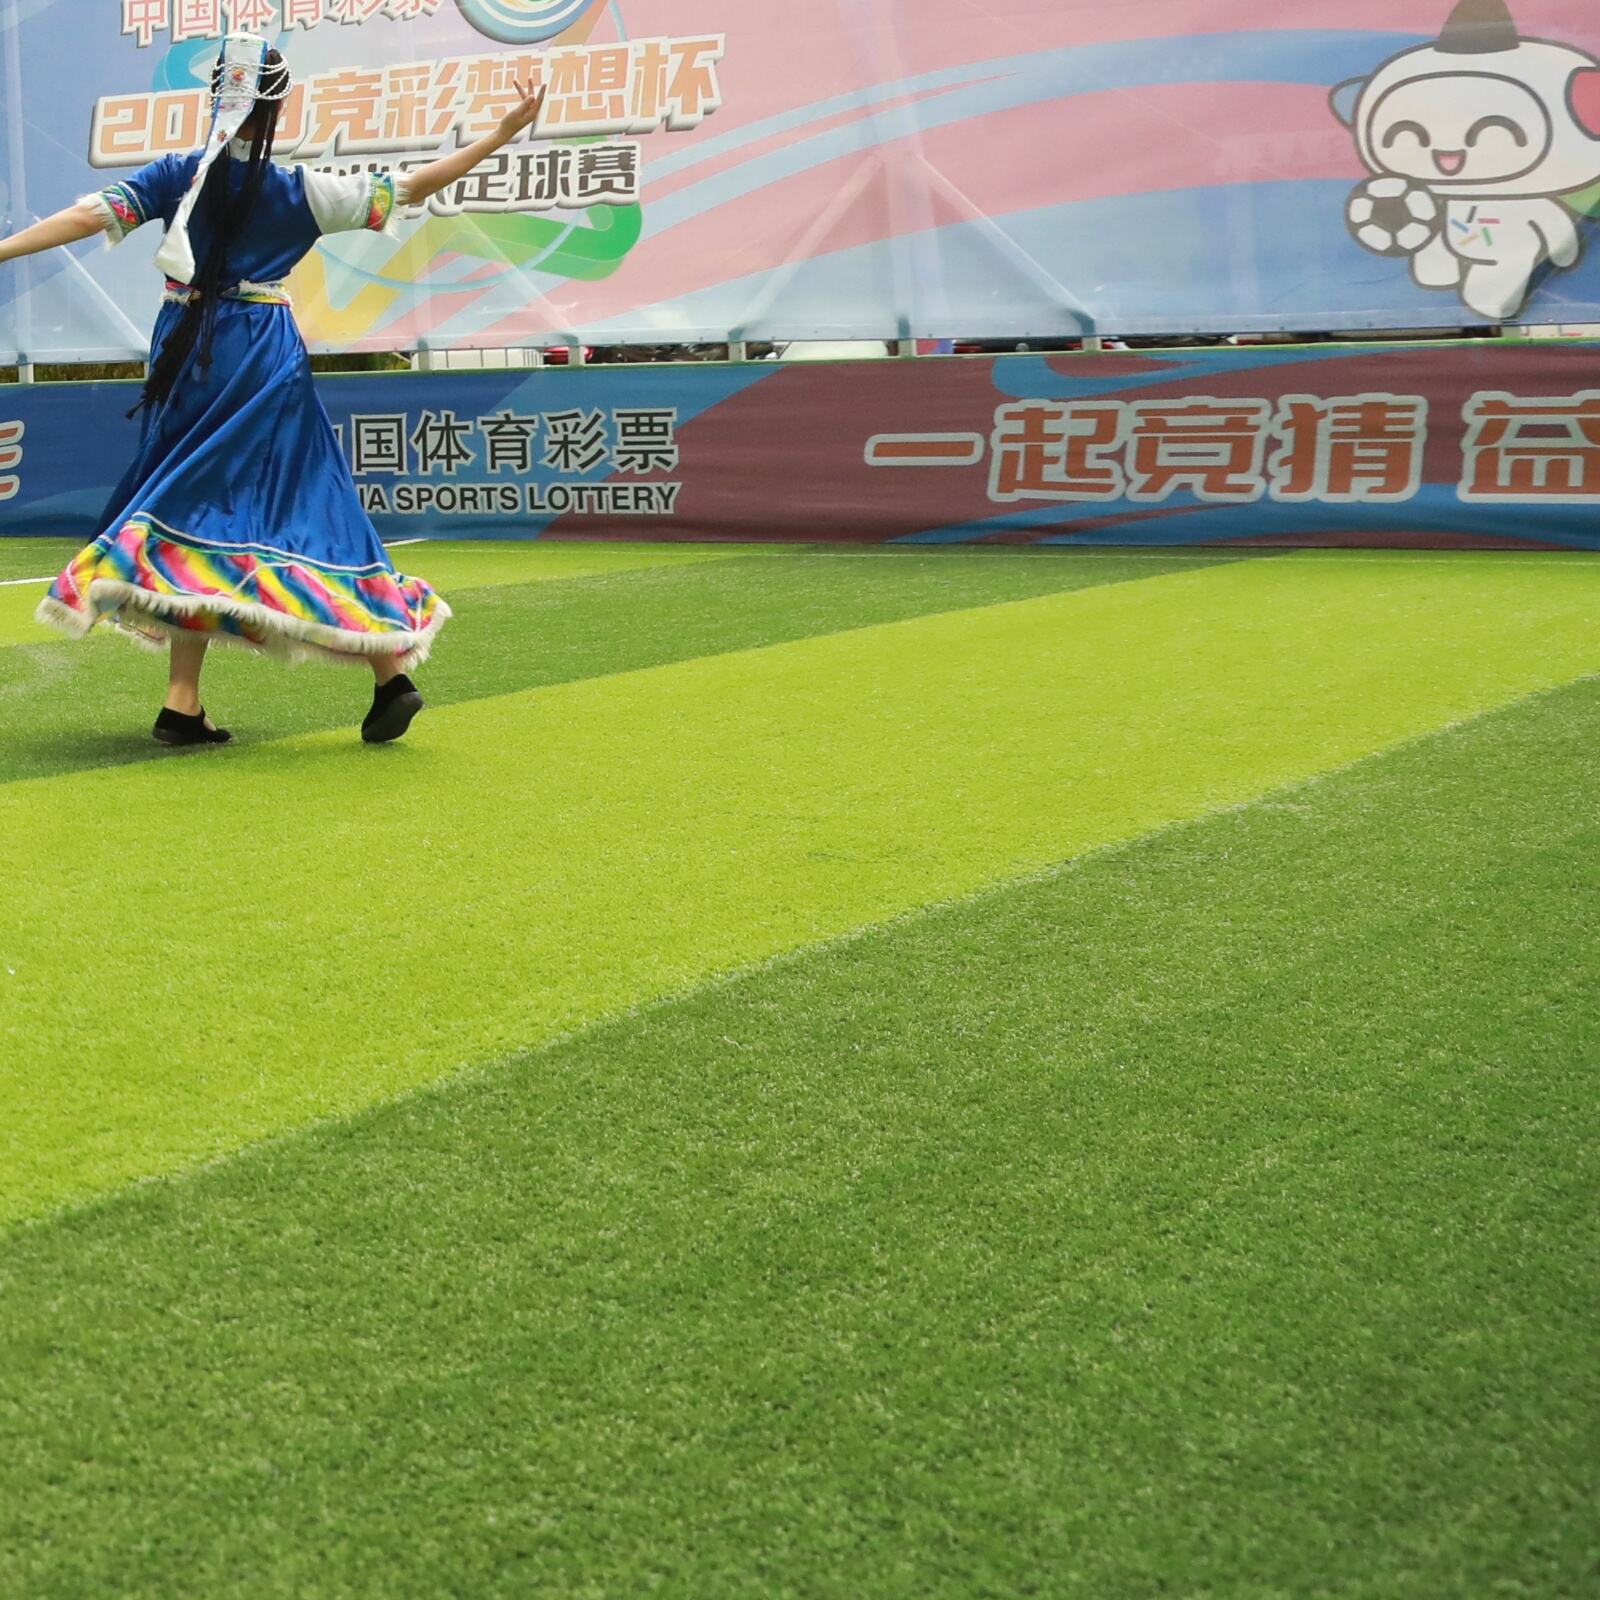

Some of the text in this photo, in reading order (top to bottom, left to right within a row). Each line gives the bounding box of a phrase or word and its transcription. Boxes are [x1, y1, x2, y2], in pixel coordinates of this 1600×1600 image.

[332, 407, 679, 476] 国体育彩票
[863, 396, 1428, 503] 一起竞猜
[393, 484, 520, 513] SPORTS
[526, 482, 682, 514] LOTTERY
